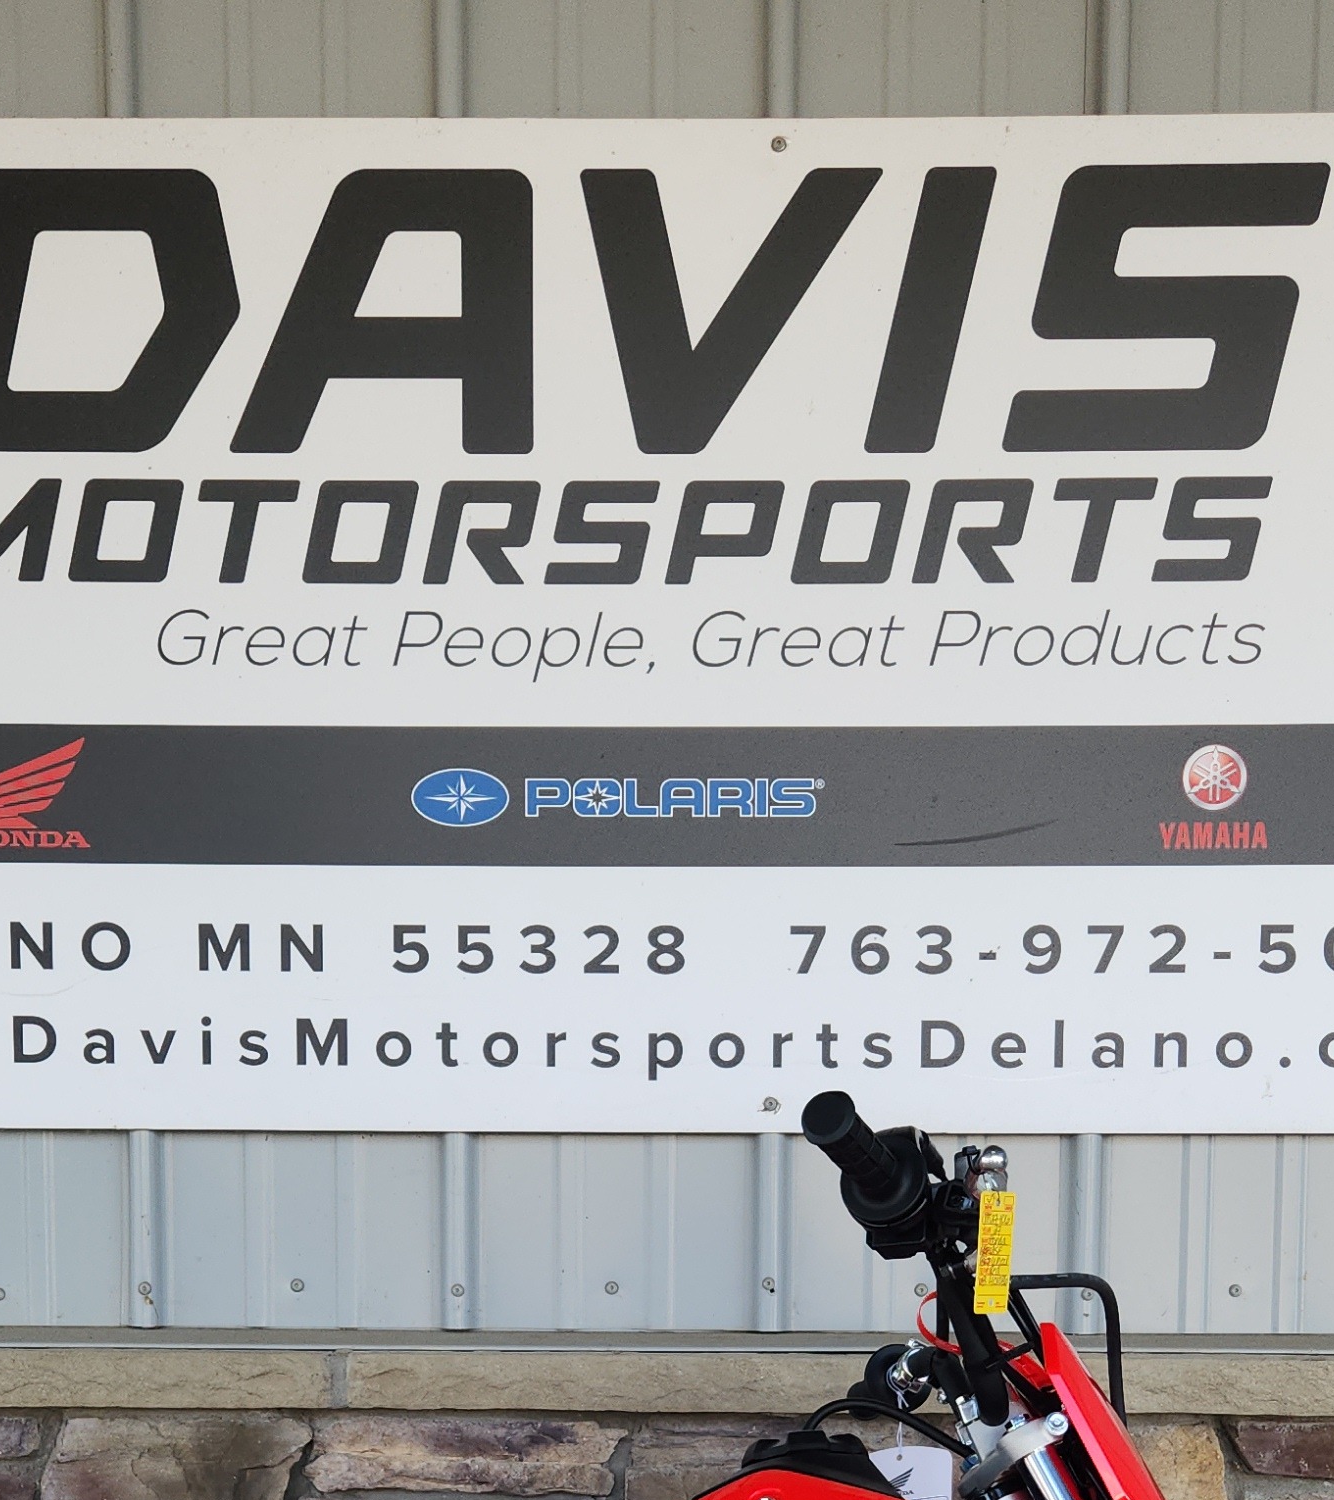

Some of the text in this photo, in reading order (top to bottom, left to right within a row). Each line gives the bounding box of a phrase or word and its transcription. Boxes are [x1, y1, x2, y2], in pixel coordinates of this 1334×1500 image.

[157, 608, 1266, 683] Great People, Great Products
[1159, 822, 1268, 848] YAMAHA
[198, 923, 324, 973] MN
[392, 924, 686, 975] 55328
